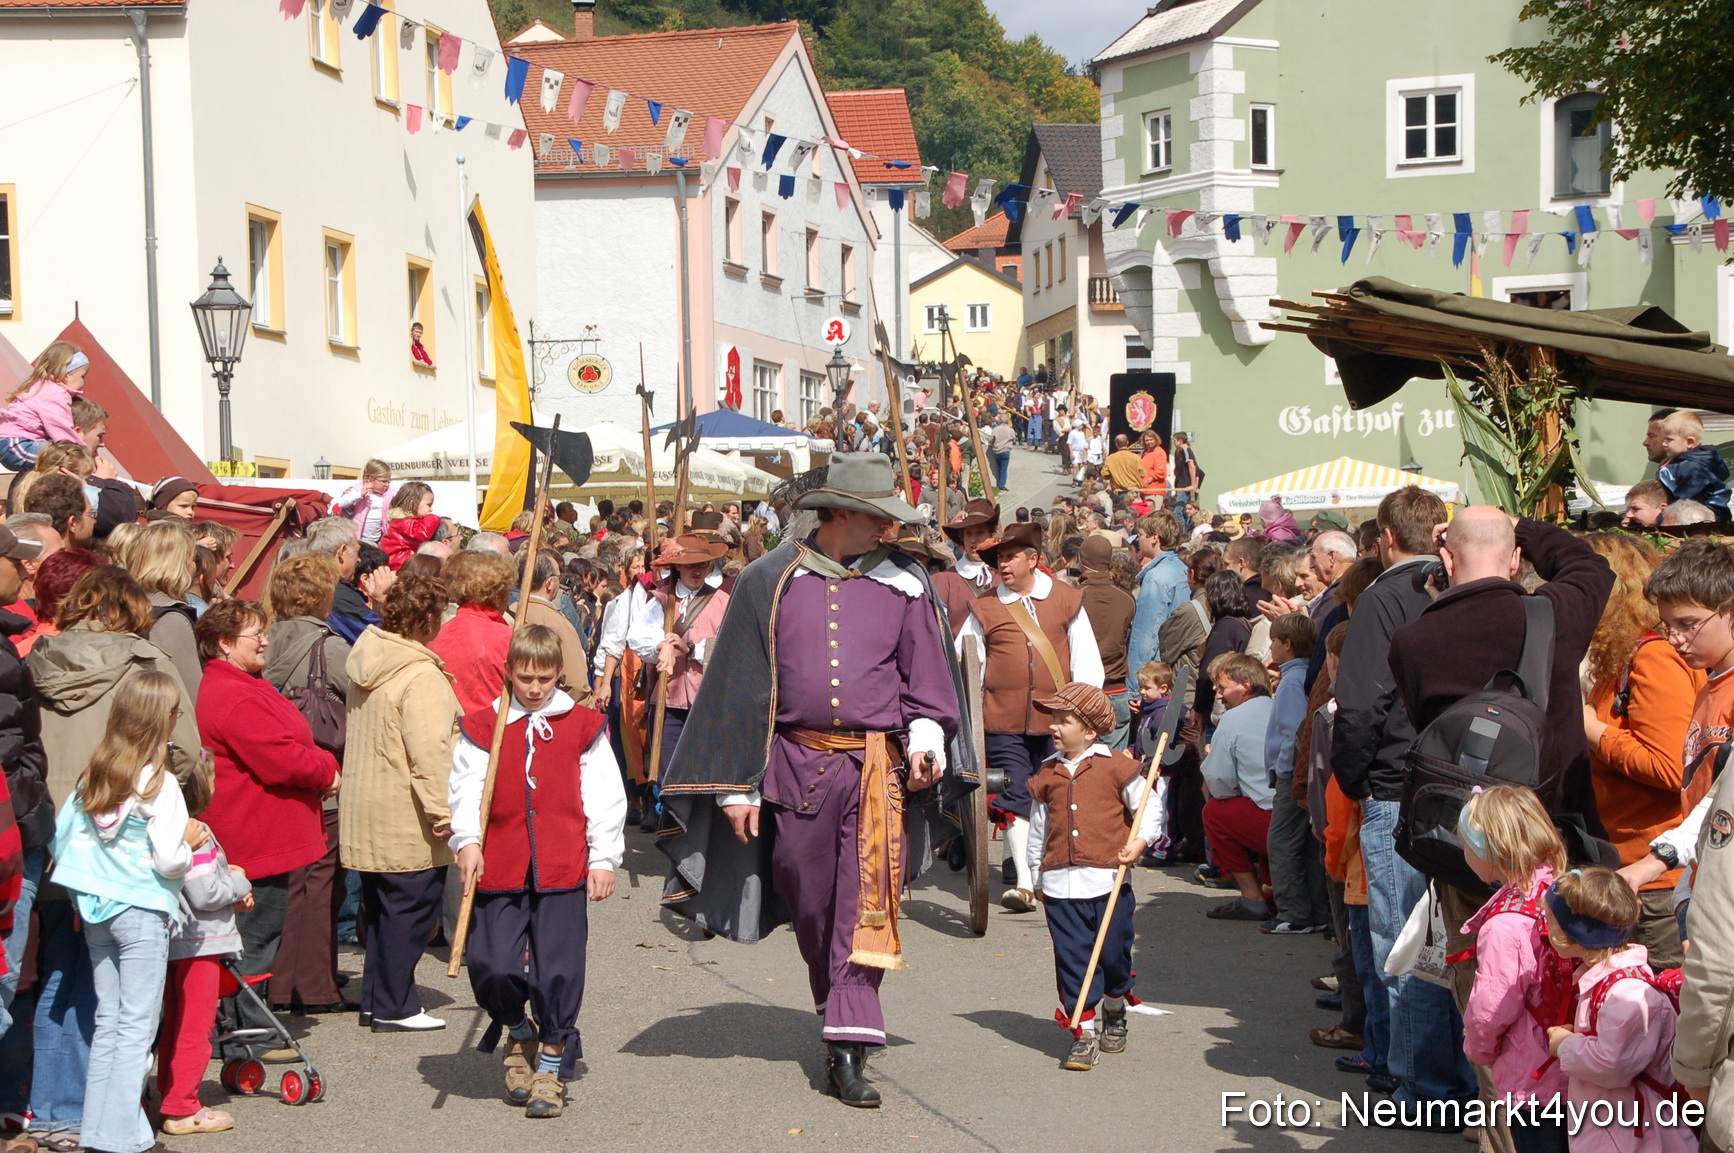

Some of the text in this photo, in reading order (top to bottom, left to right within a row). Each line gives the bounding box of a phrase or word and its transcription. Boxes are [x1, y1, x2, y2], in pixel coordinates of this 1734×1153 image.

[367, 396, 406, 428] Gasthof
[410, 411, 430, 431] zum
[388, 457, 489, 472] EDENBURGER WEISE
[1281, 495, 1326, 506] Kuchlbauer
